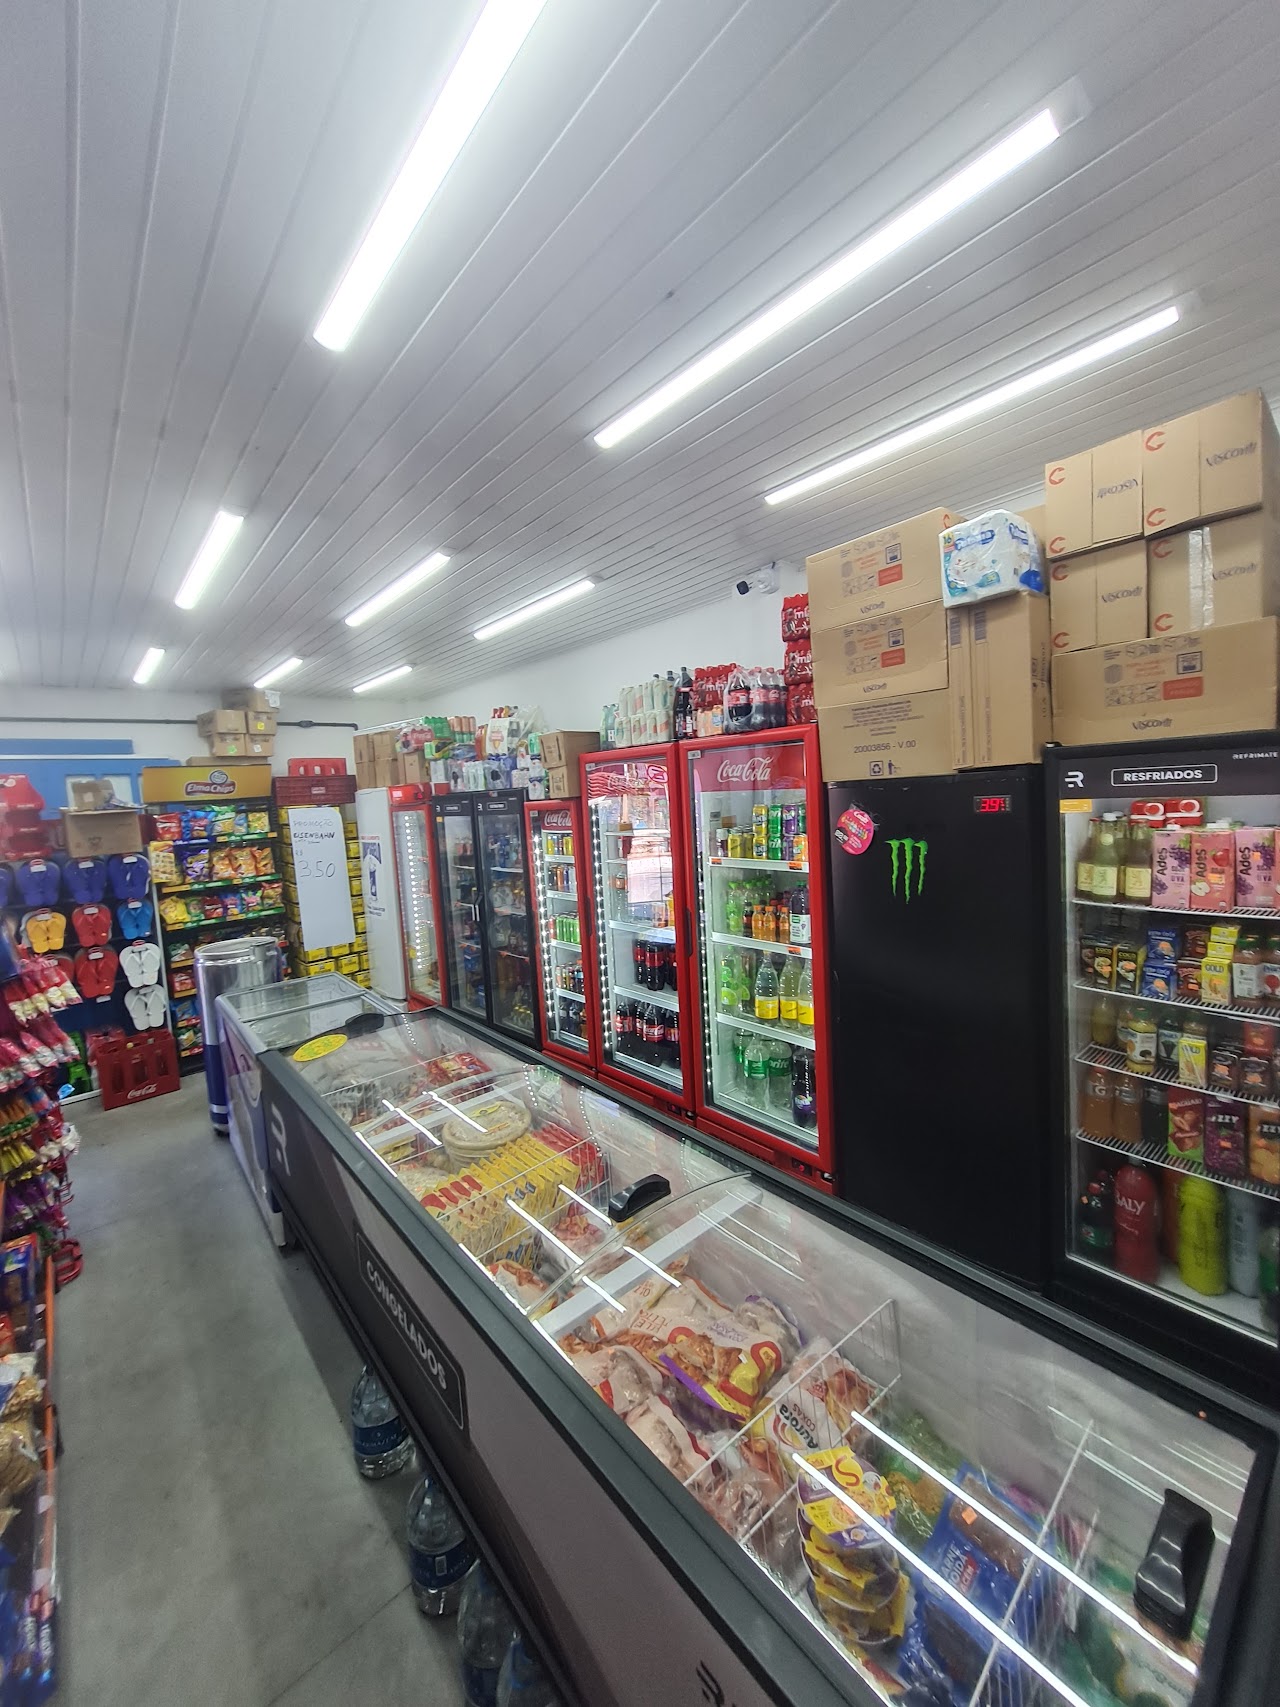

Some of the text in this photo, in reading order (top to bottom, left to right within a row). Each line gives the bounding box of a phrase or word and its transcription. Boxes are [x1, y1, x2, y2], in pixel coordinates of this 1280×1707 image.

[1101, 586, 1143, 603] Visconti
[1132, 718, 1173, 731] Visconti
[854, 742, 891, 754] 20003856
[1232, 751, 1278, 760] REFRIMATE
[717, 756, 774, 783] Coca-Cola
[1123, 769, 1203, 782] RESFRIADOS
[187, 783, 235, 794] Elma Chips
[1157, 847, 1168, 876] AdeS
[1195, 848, 1207, 878] AdeS
[1239, 846, 1251, 876] AdeS
[1171, 875, 1185, 883] UVA
[1205, 964, 1224, 973] GOLD
[366, 1260, 447, 1391] CONGELADOS
[779, 1404, 818, 1449] Aurora
[792, 1403, 816, 1432] COXAS
[940, 1543, 961, 1578] ARNE
